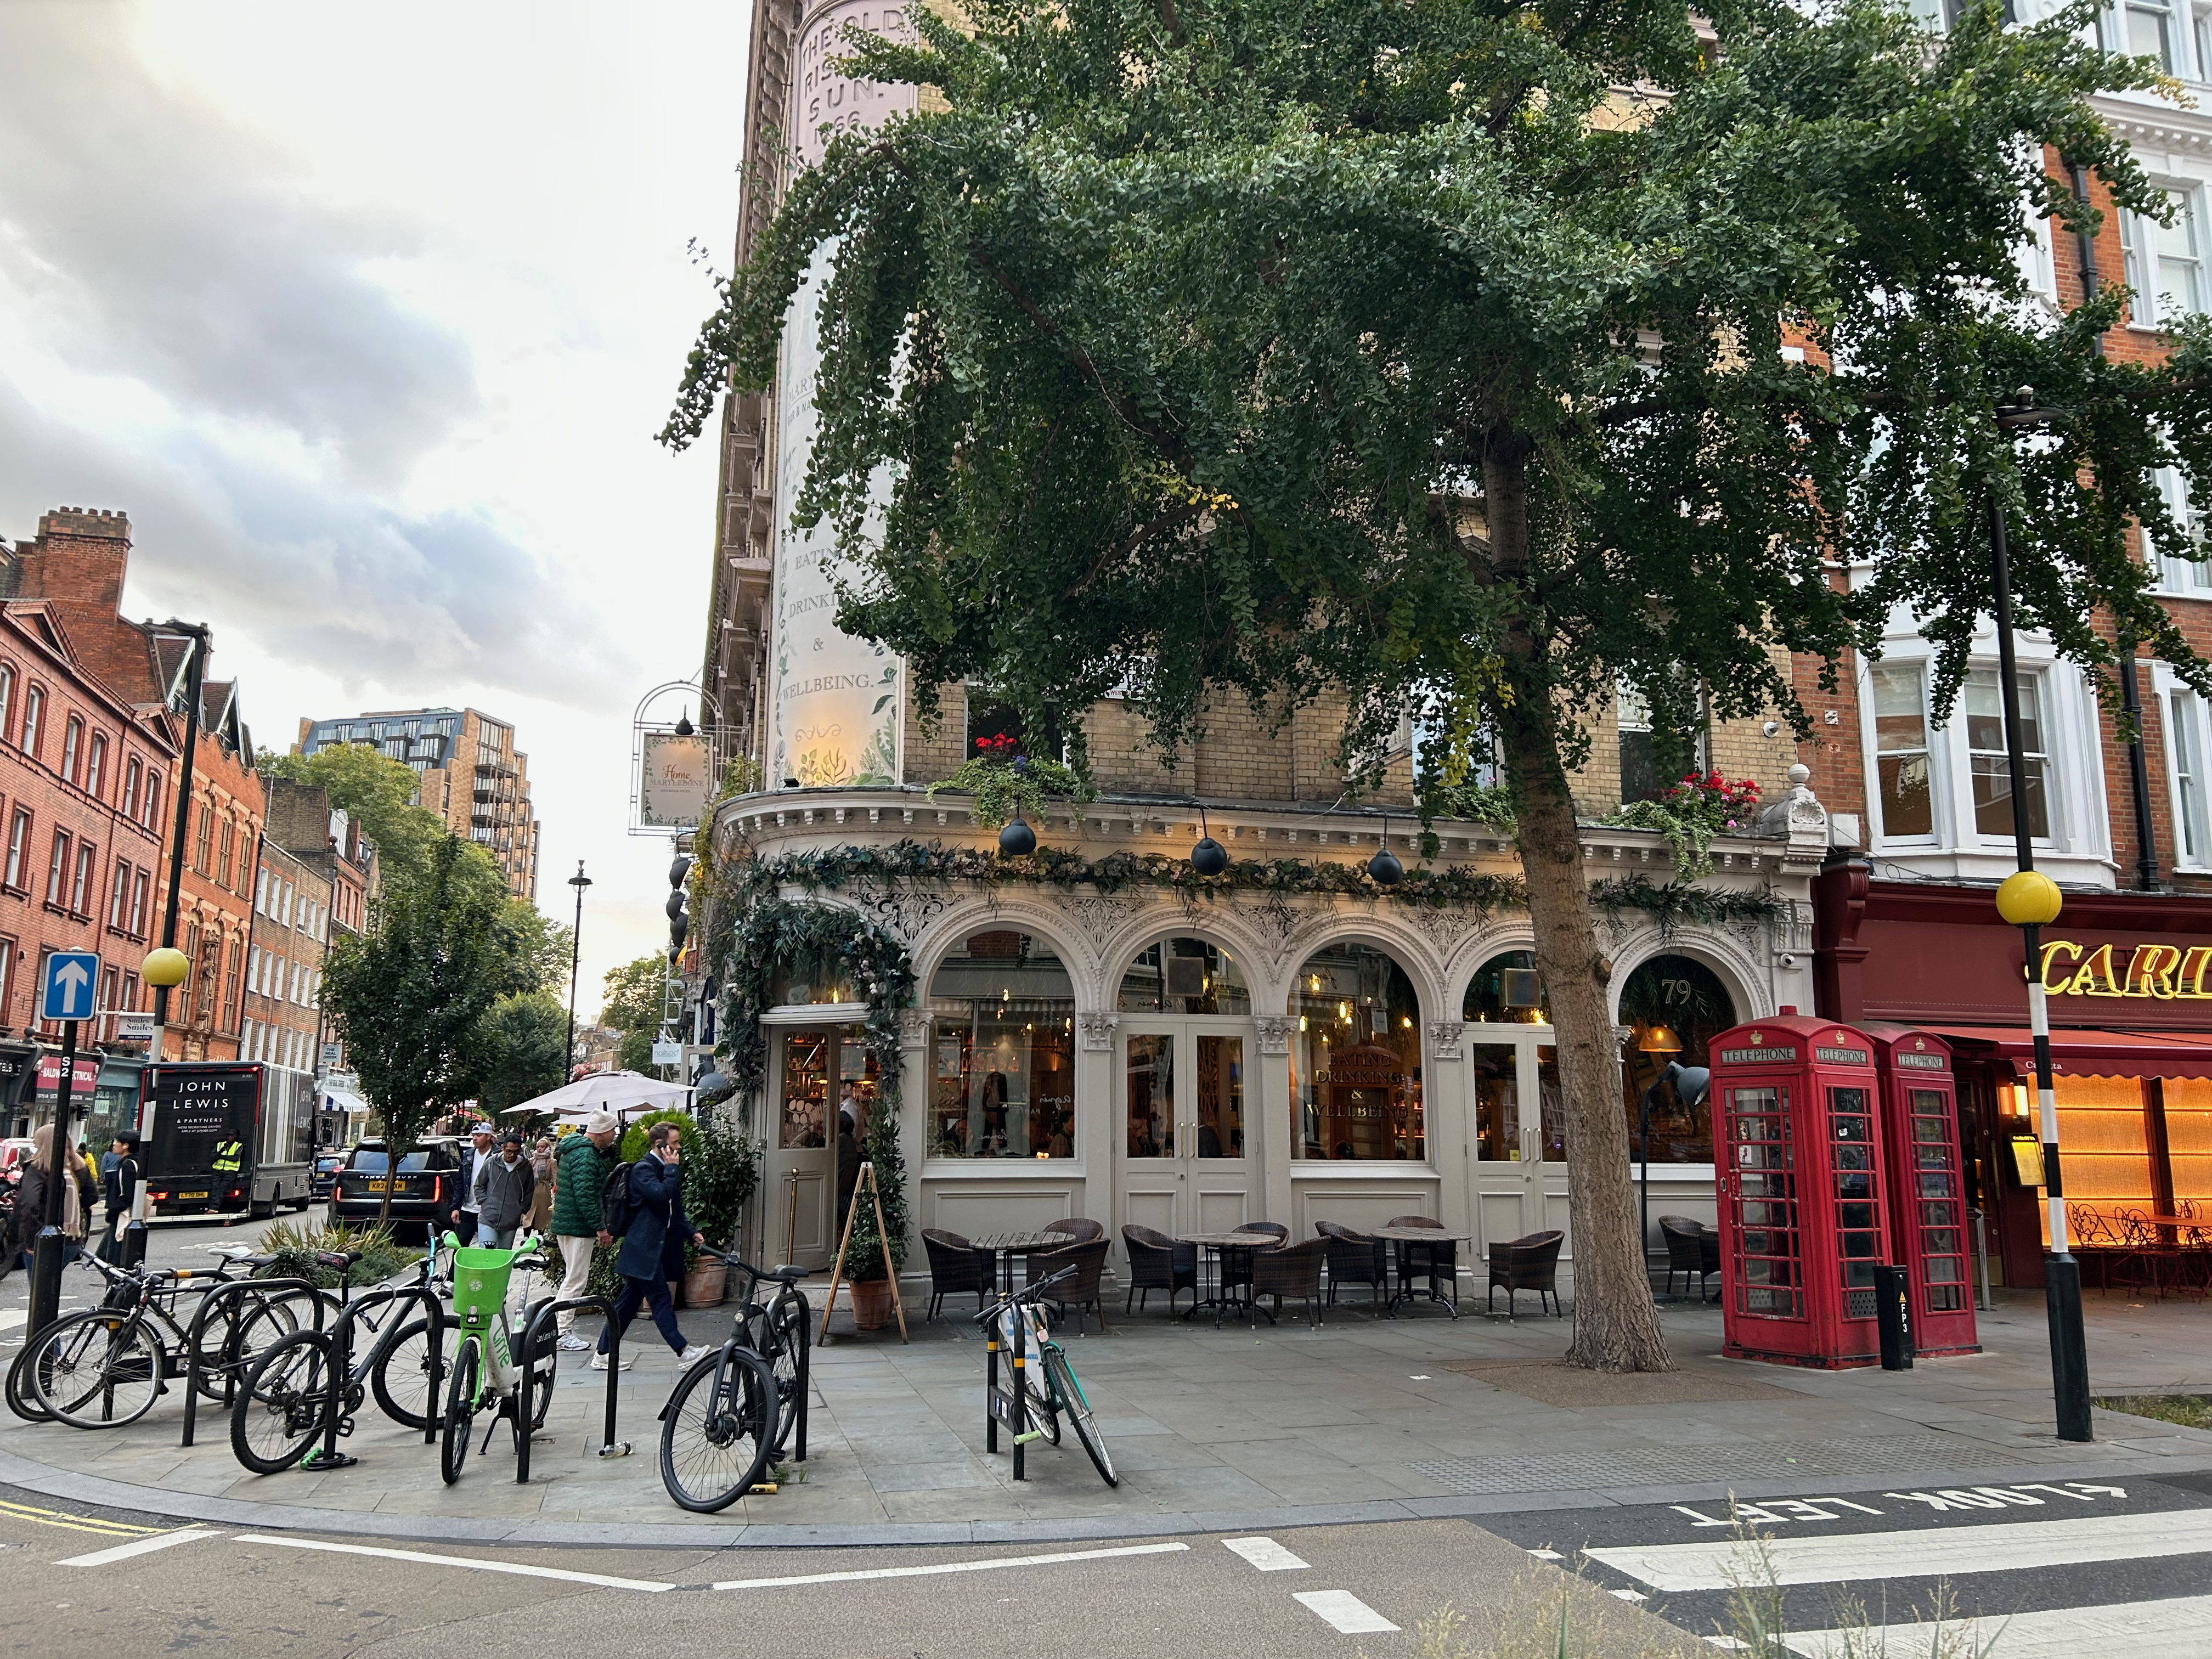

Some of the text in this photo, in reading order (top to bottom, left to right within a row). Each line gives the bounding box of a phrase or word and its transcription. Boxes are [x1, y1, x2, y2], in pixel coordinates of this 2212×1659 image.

[803, 9, 904, 72] THE OLD
[795, 548, 838, 570] EATIN
[789, 593, 839, 618] DRINKI
[814, 637, 824, 651] &
[782, 674, 874, 701] WELLBEING.
[662, 764, 691, 781] Home
[650, 778, 704, 787] MARYLEBONE
[1662, 979, 1691, 1005] 79
[1328, 1053, 1392, 1066] EATING
[1724, 1047, 1795, 1062] TELEPHONE
[1816, 1048, 1865, 1063] TELEPHONE
[1899, 1054, 1943, 1068] TELEPHONE
[43, 1067, 60, 1079] BALDW
[1316, 1069, 1401, 1084] DRINKING
[179, 1081, 225, 1093] JOHN
[1351, 1088, 1363, 1099] &
[173, 1099, 229, 1109] LEWIS
[1307, 1104, 1408, 1118] WELLBEING
[493, 1324, 510, 1368] Lime
[1668, 1483, 2095, 1527] LOOK LEFT
